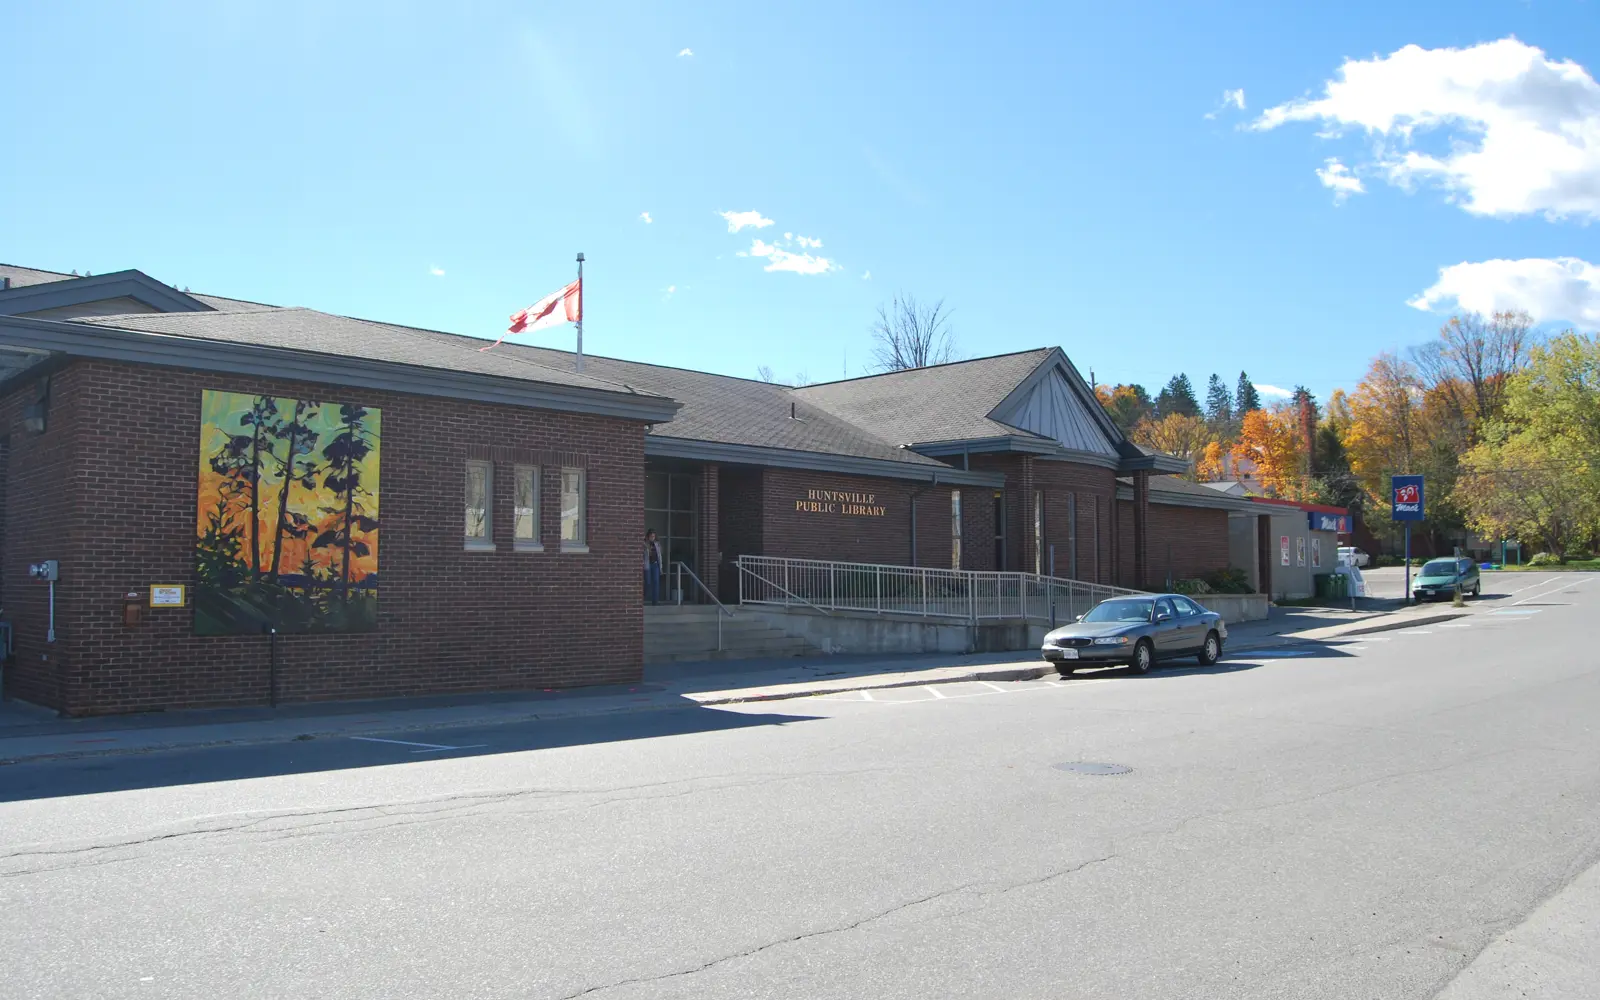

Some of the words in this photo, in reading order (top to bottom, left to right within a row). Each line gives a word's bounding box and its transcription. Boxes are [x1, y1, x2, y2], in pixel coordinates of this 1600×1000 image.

[808, 489, 875, 504] HUNTSVILLE
[796, 500, 836, 513] PUBLIC
[842, 504, 886, 516] LIBRARY
